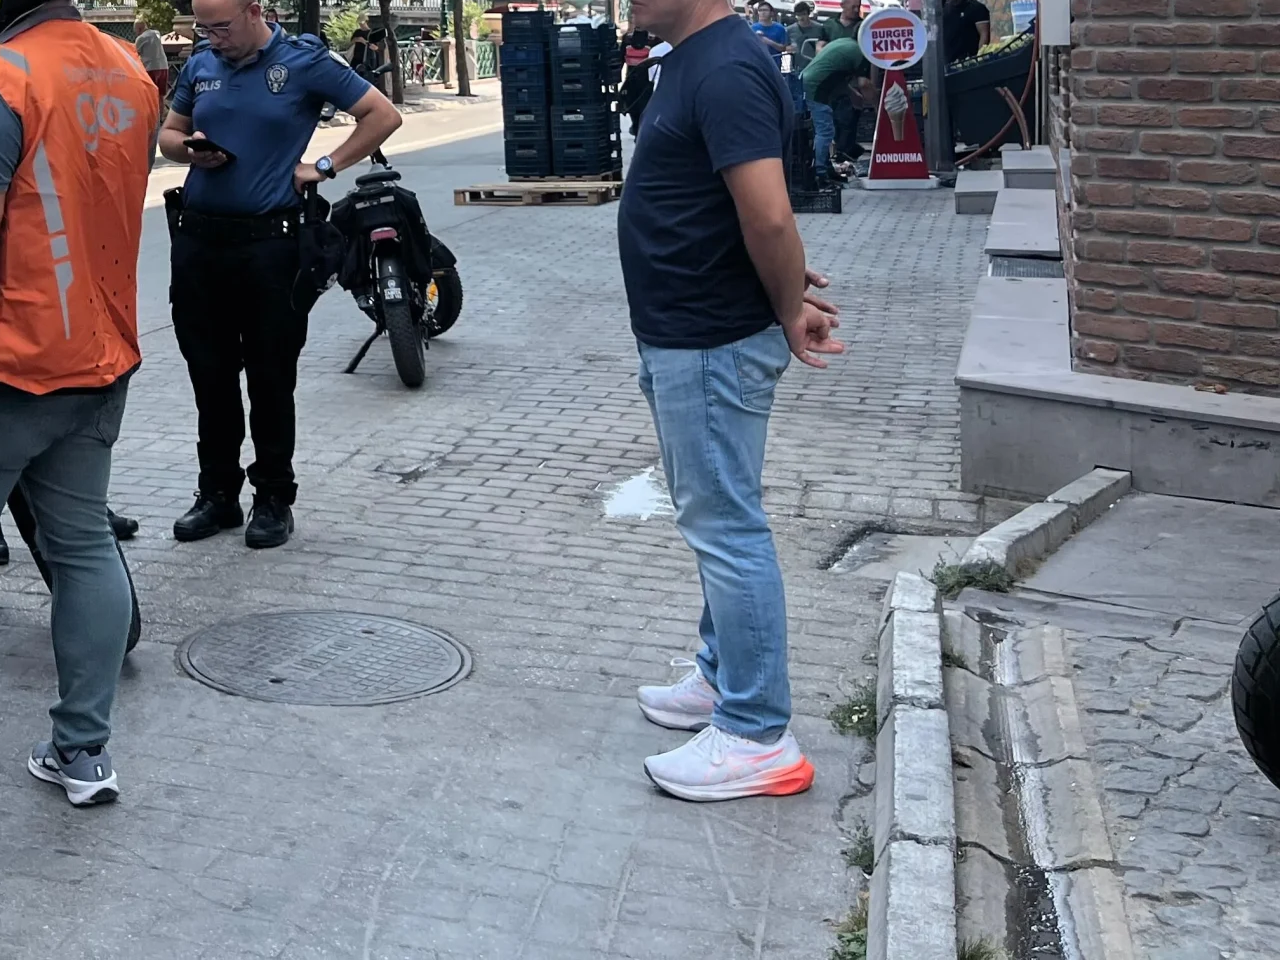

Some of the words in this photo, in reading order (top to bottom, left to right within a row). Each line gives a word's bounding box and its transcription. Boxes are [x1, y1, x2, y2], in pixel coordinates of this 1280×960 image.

[871, 29, 914, 40] BURGER
[872, 38, 915, 52] KING
[875, 153, 923, 163] DONDURMA
